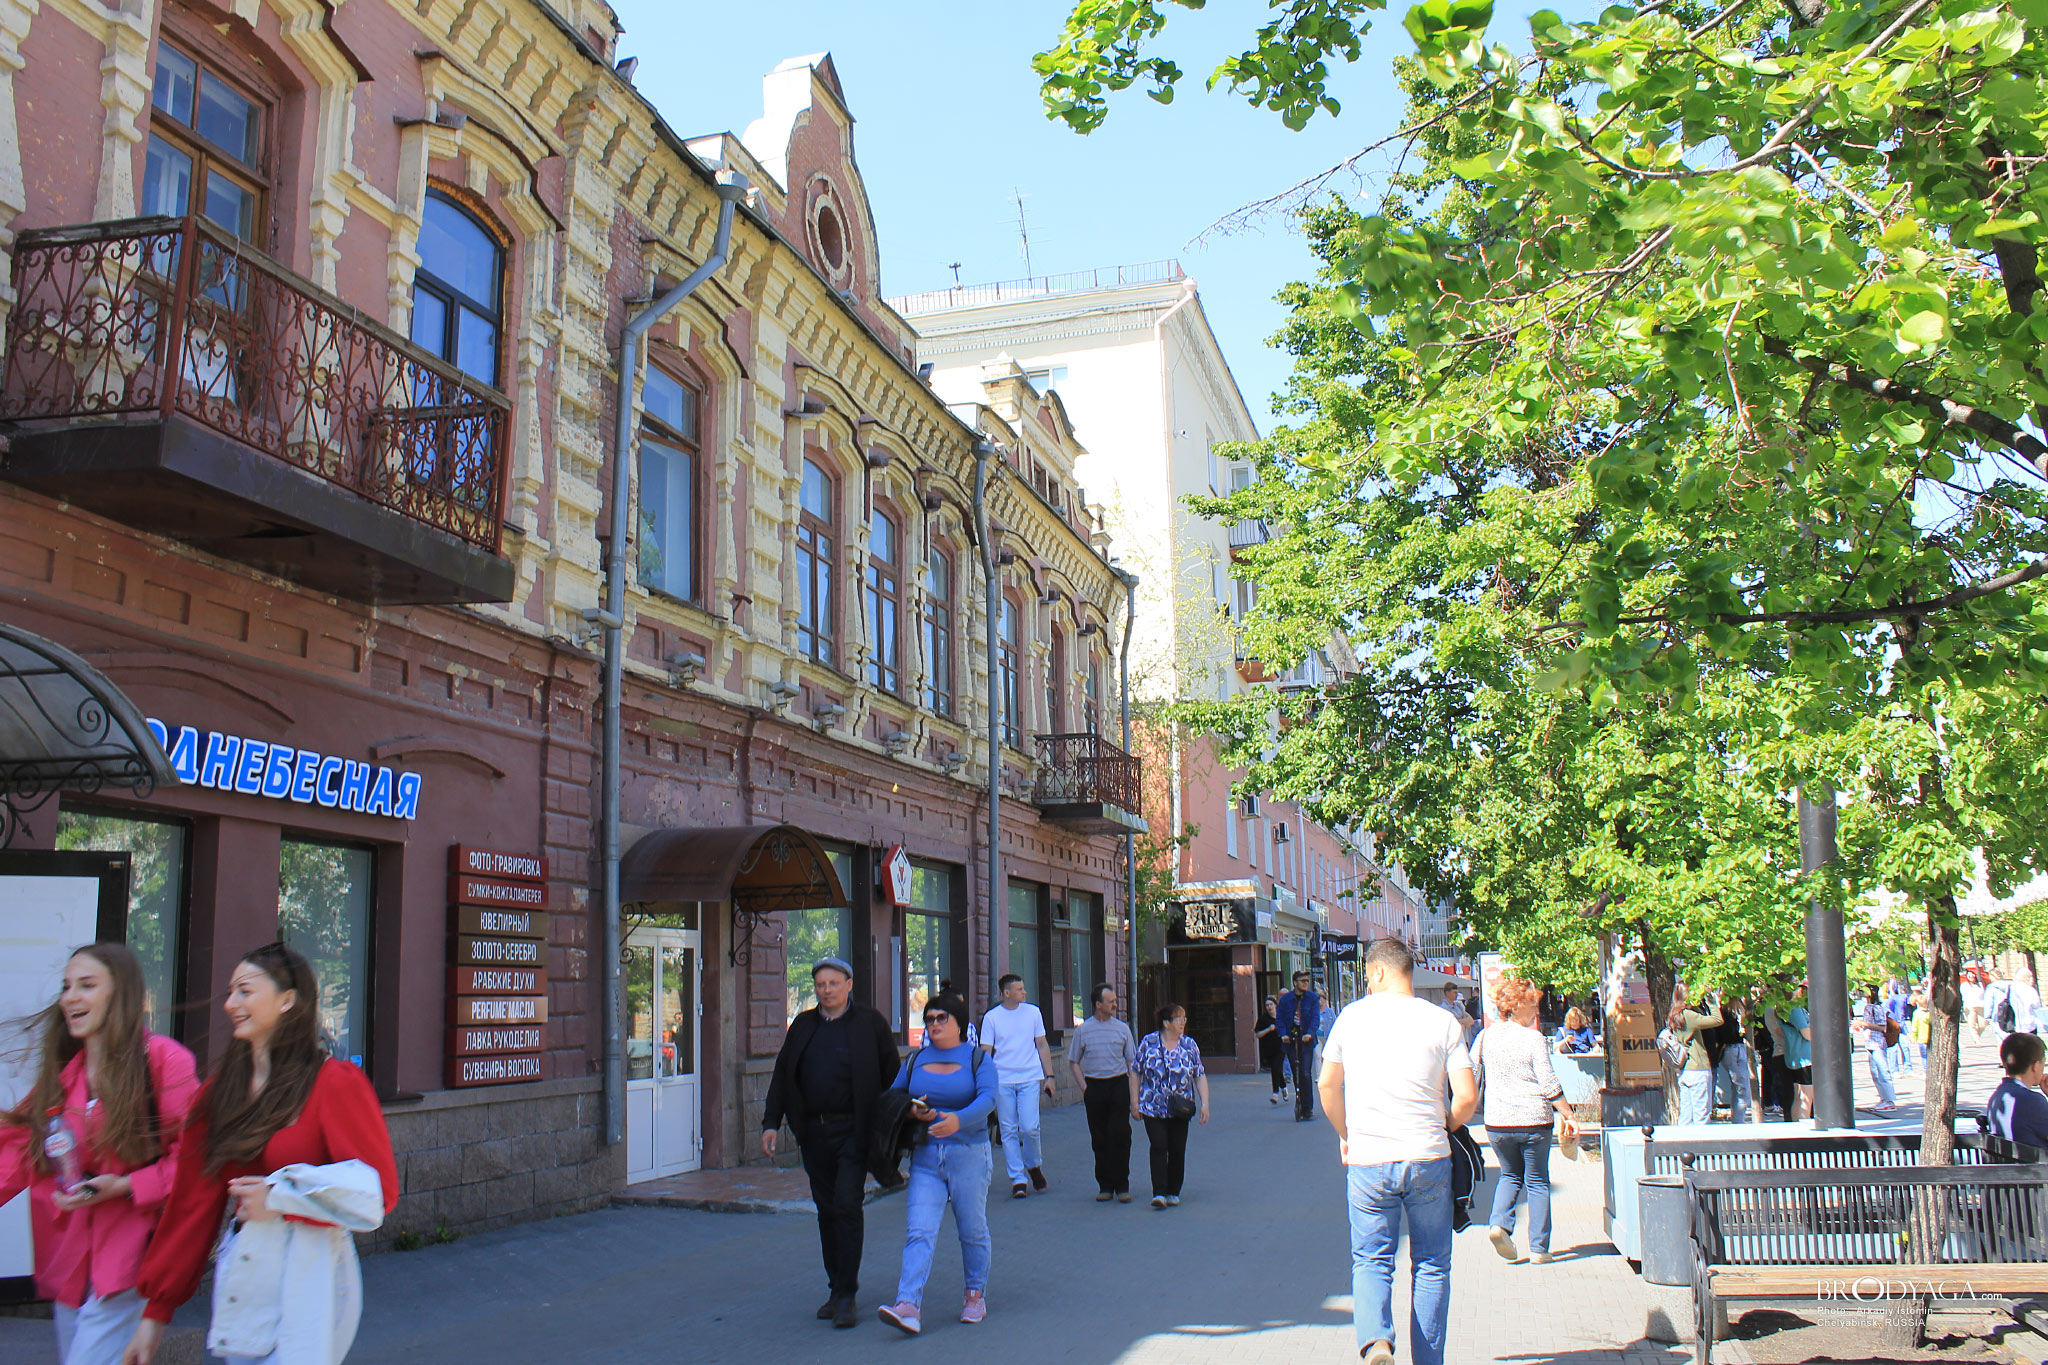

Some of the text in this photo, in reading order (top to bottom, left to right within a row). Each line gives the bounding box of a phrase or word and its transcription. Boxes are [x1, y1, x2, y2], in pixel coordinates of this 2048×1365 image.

[480, 912, 530, 932] ЮВЕЛИРНЫЙ
[472, 971, 535, 991] АРАБСКИЕ ДУХИ
[465, 1029, 540, 1051] ЛАВКА РУКОДЕЛИЯ
[1622, 1038, 1657, 1051] КИН
[463, 1058, 540, 1081] СУВЕНИРЫ ВОСТОКА
